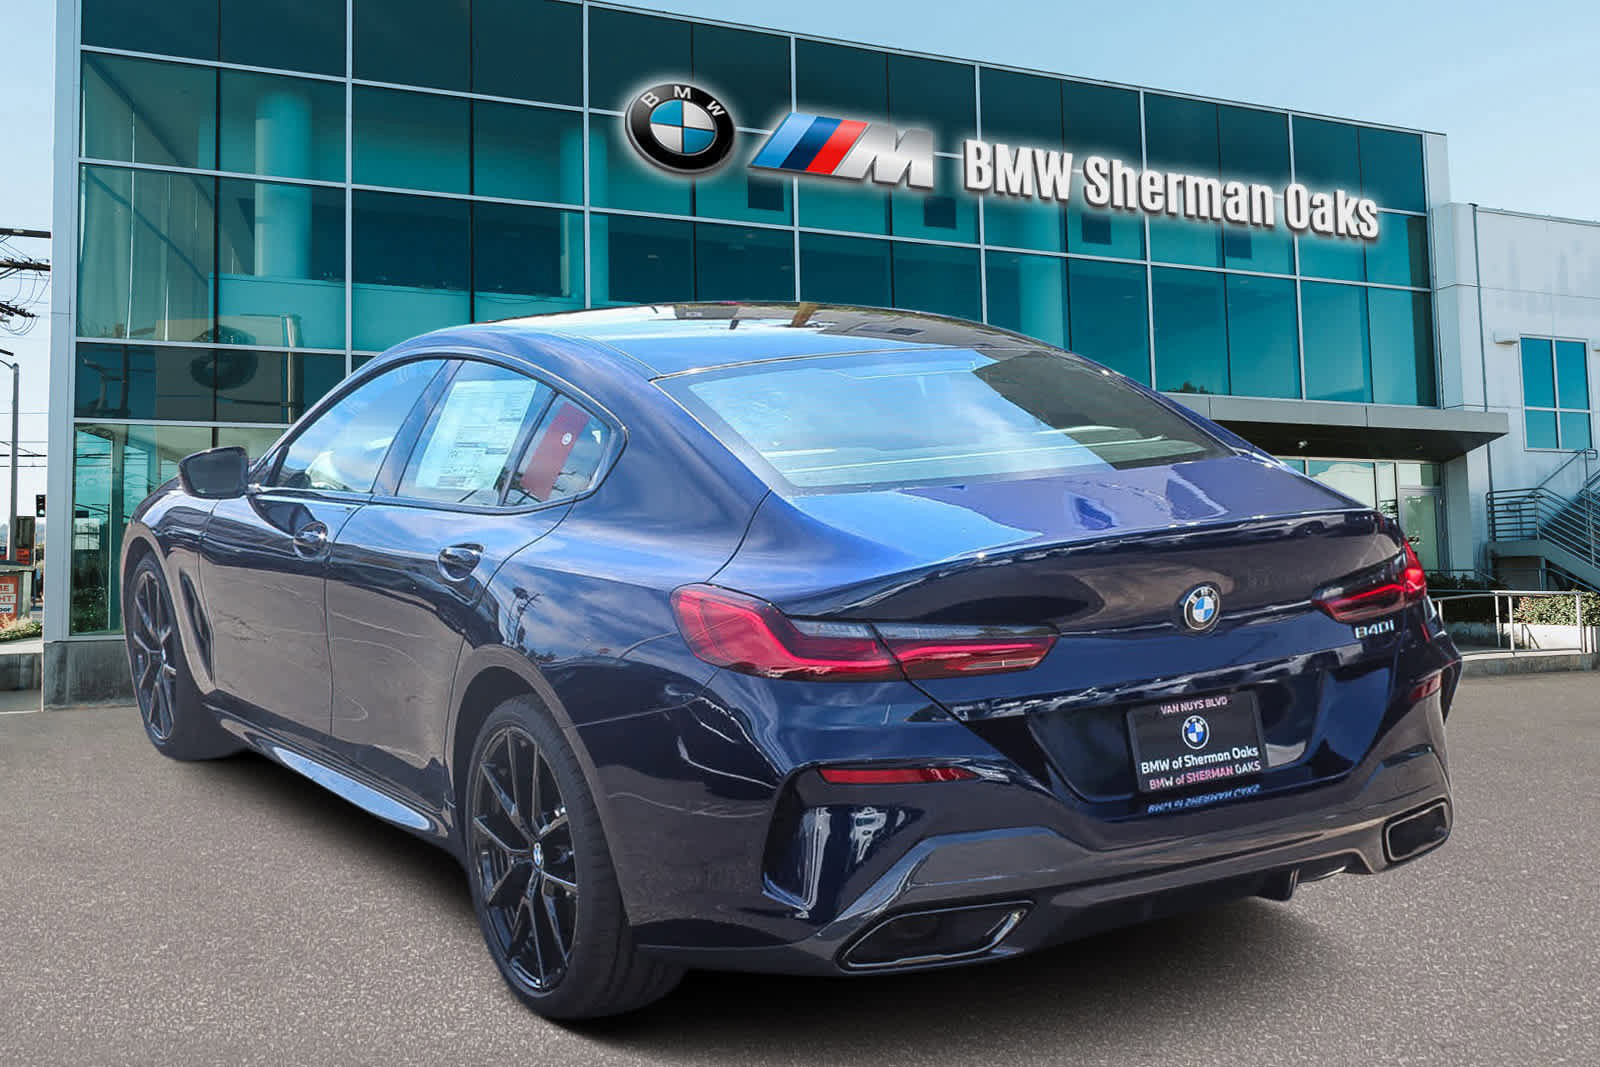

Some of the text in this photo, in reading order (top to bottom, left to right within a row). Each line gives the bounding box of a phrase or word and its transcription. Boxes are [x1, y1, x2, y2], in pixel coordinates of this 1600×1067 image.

[963, 139, 1379, 240] BMW Sherman Oaks
[1160, 696, 1228, 714] VAN NUYS BLVD
[1141, 746, 1258, 774] BMW of Sherman Oaks
[1149, 760, 1261, 790] BMW of SHERMAN OAKS
